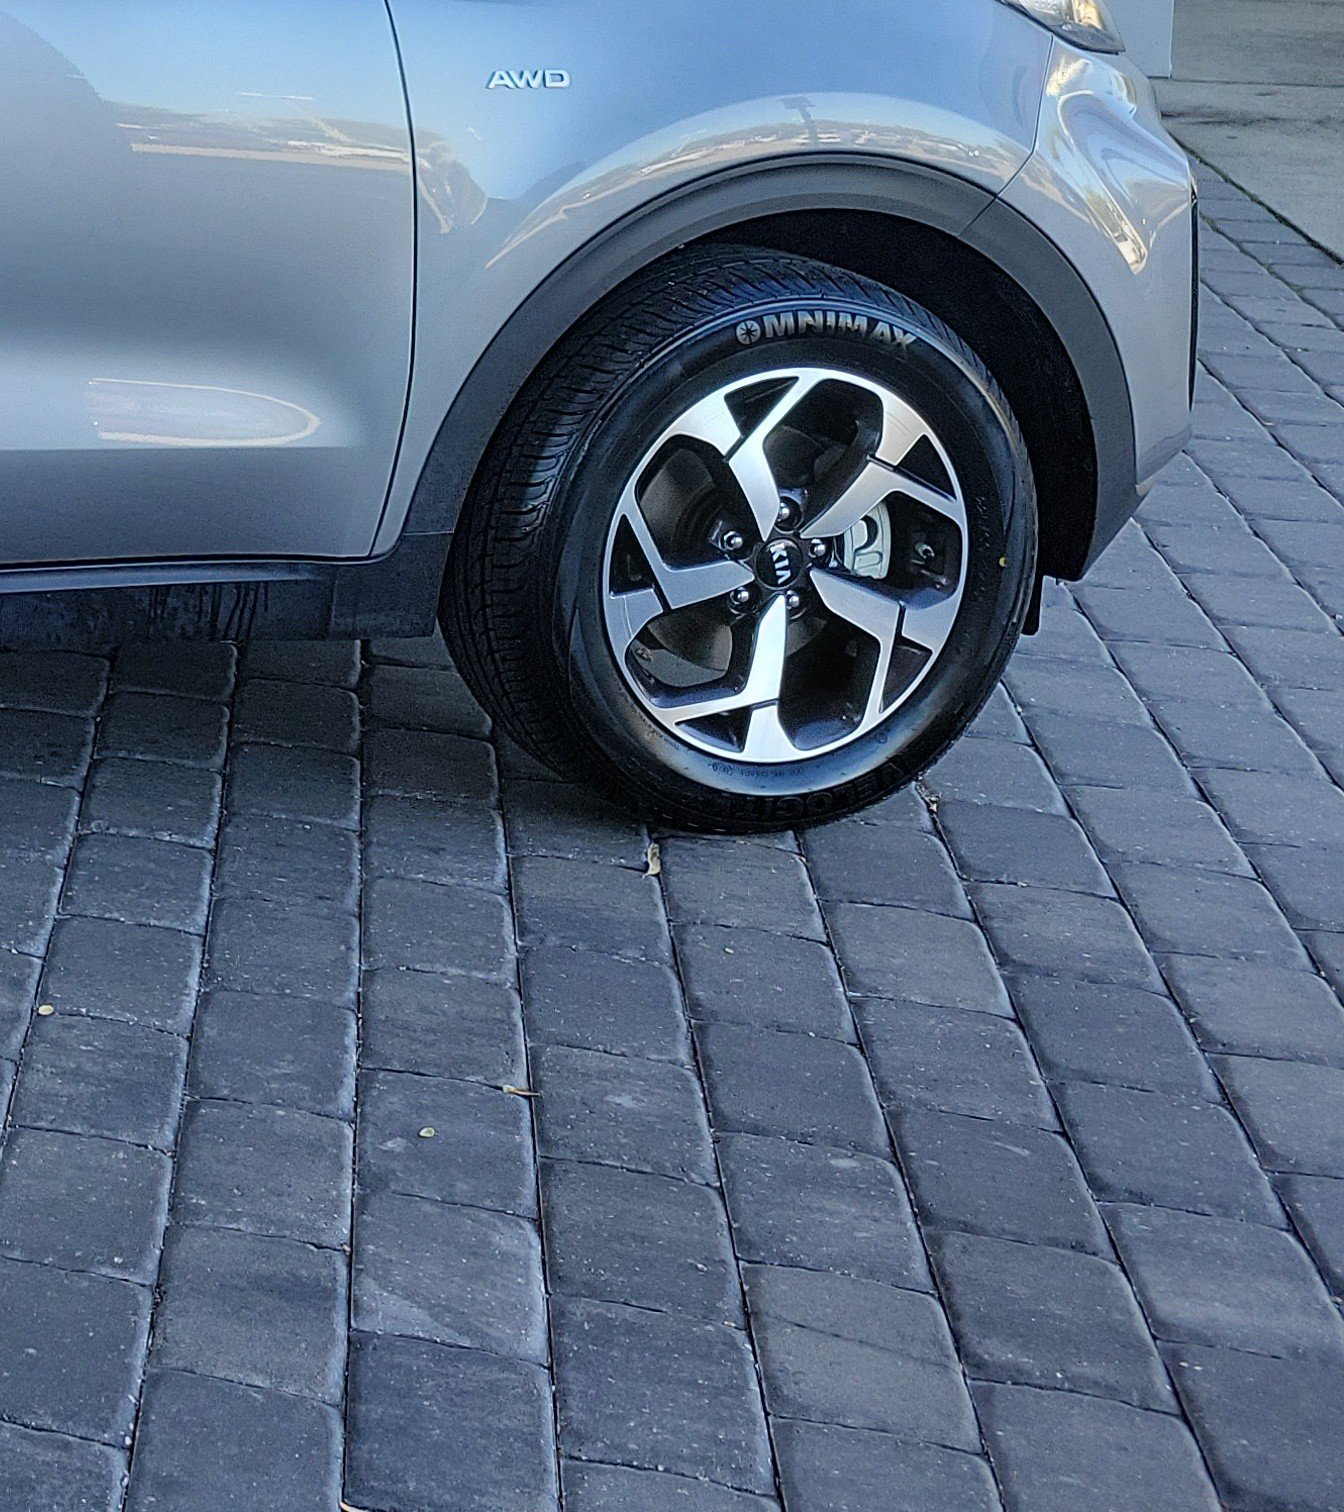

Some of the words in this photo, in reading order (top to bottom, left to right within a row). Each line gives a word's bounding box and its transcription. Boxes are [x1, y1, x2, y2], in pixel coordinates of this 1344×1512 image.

[486, 69, 571, 89] AWD
[735, 310, 917, 358] OMNIMAX
[769, 541, 791, 586] KIA
